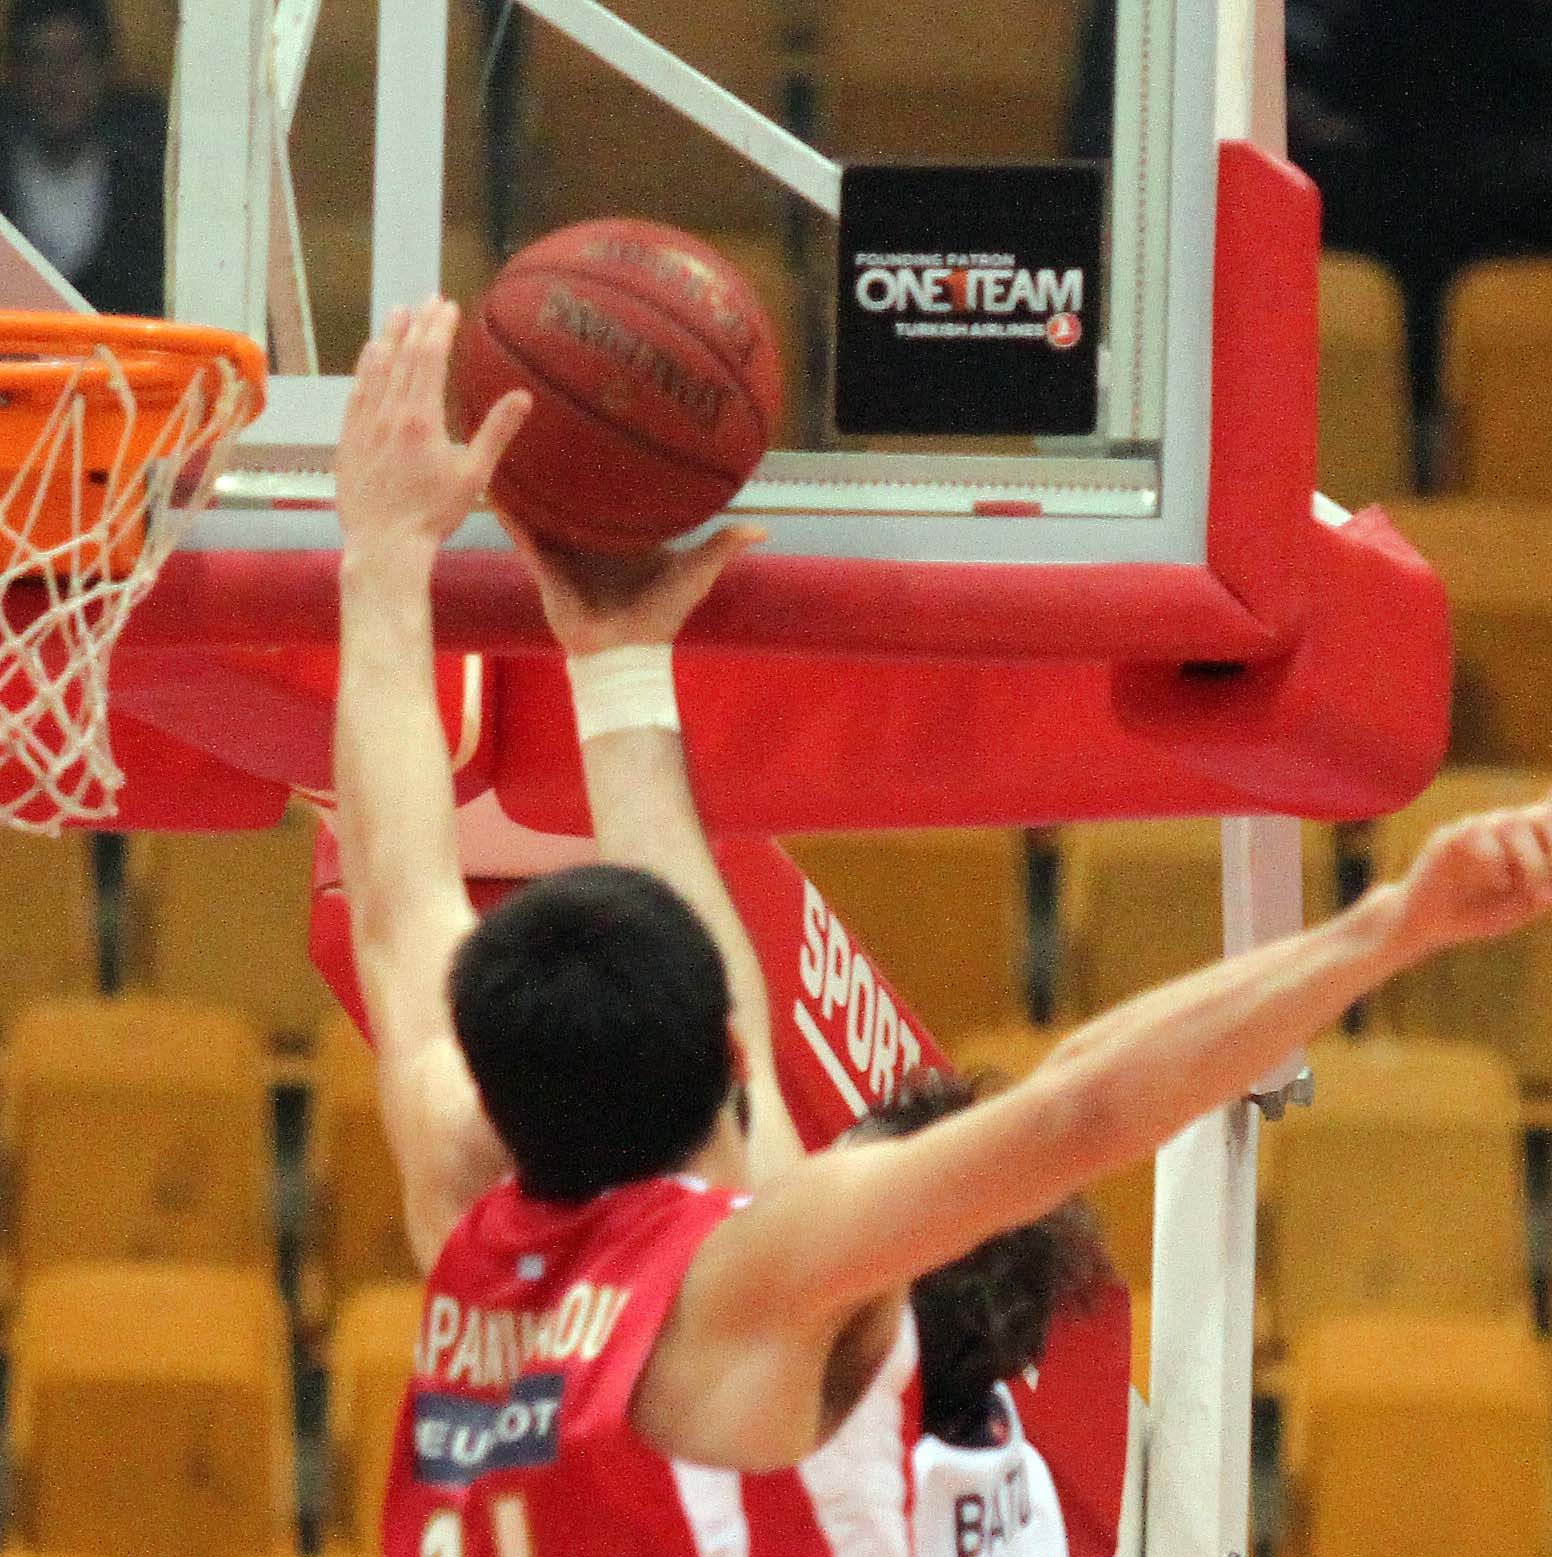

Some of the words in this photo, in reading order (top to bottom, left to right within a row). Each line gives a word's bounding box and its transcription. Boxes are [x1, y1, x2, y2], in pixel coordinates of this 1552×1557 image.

[854, 252, 943, 266] FOUNDING
[946, 252, 1016, 266] PATRON
[895, 322, 966, 337] TURKISH
[969, 322, 1046, 337] AIRLINES
